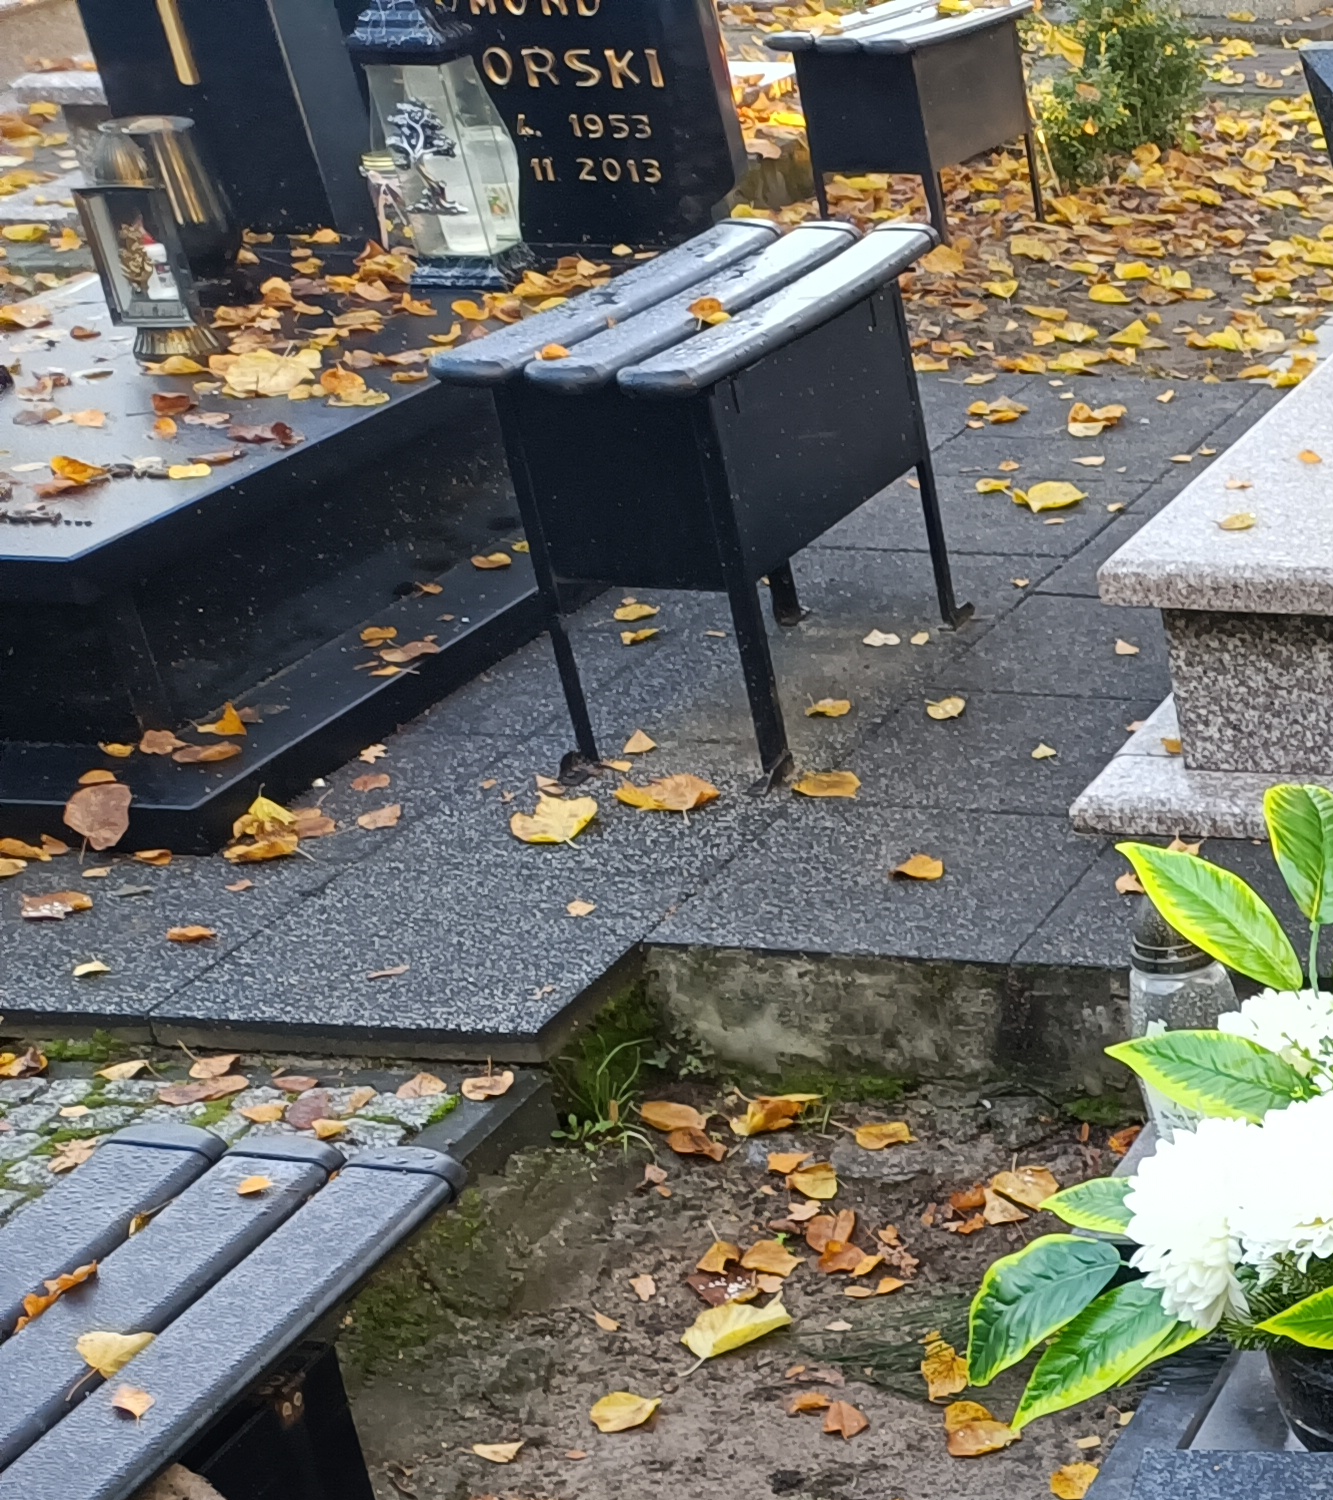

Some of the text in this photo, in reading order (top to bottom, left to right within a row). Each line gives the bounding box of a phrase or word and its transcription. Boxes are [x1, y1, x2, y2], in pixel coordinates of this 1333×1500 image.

[481, 46, 666, 89] ORSKI
[568, 113, 652, 139] 1953
[575, 157, 662, 183] 2013
